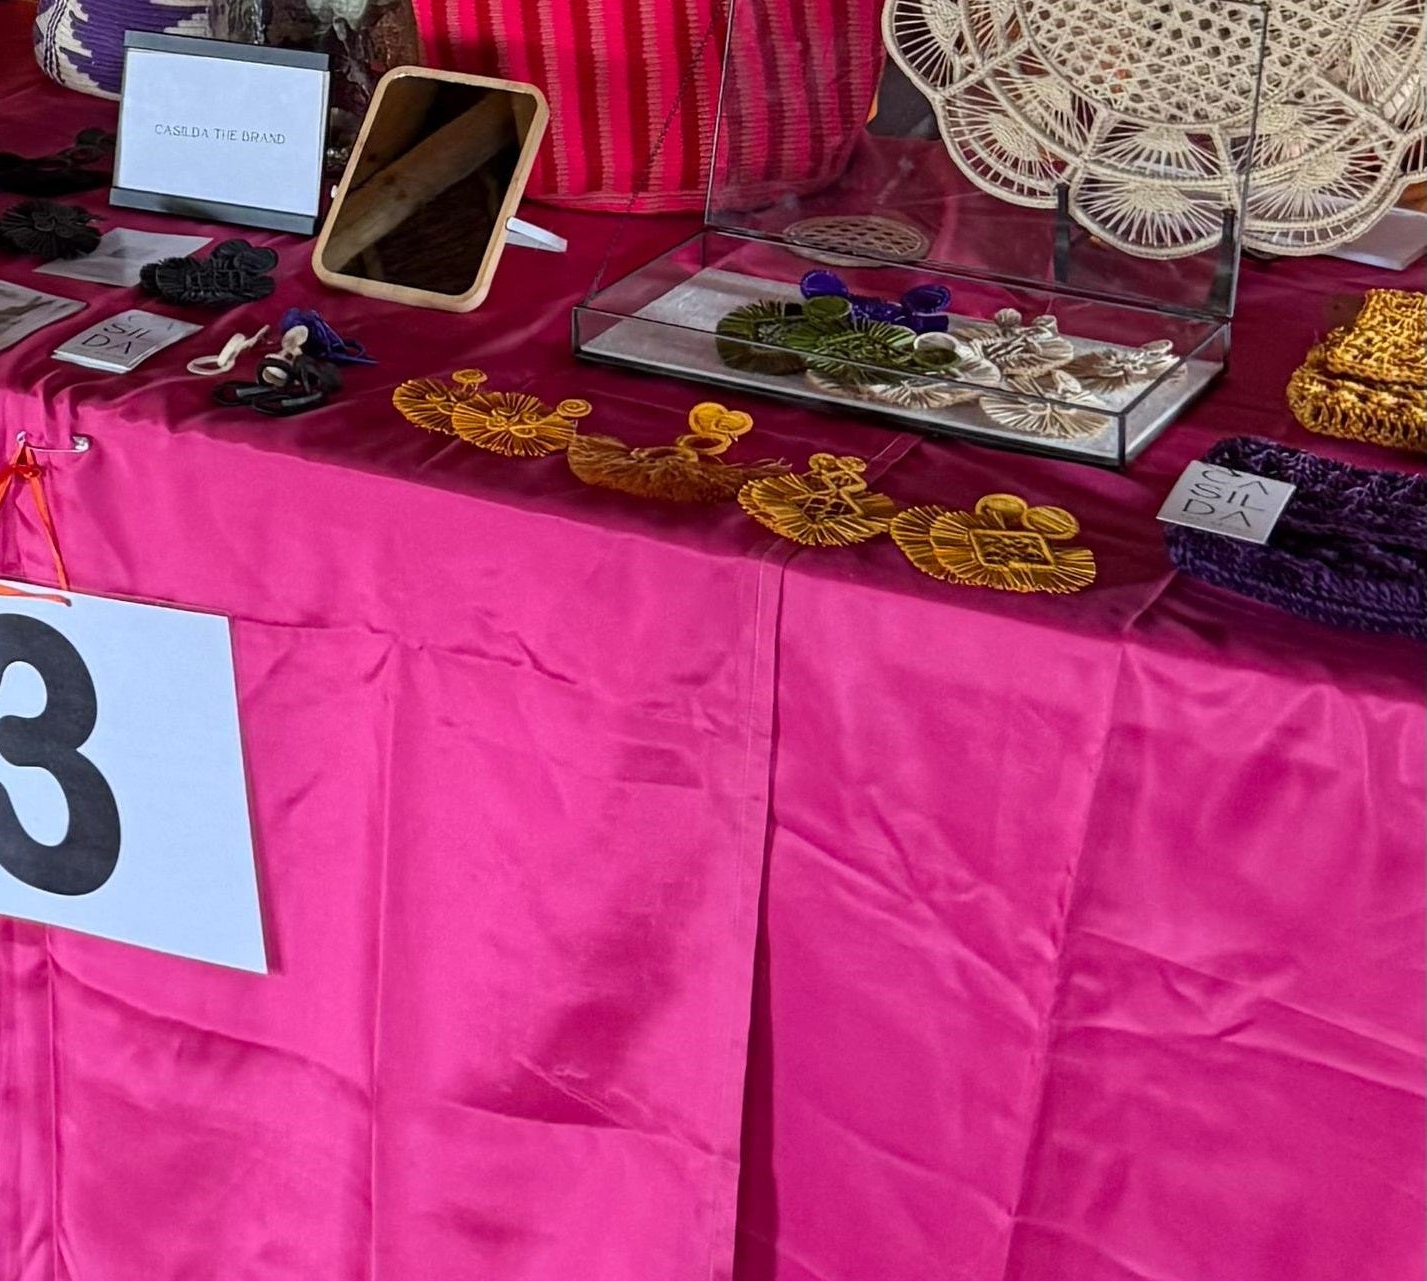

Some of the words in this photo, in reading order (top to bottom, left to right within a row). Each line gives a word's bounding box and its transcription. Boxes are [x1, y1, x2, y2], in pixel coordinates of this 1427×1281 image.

[154, 123, 209, 140] CASILDA
[214, 127, 237, 141] THE
[241, 130, 286, 145] BRAND
[81, 333, 132, 355] DA
[1189, 482, 1266, 512] SIL
[1182, 498, 1252, 528] DA
